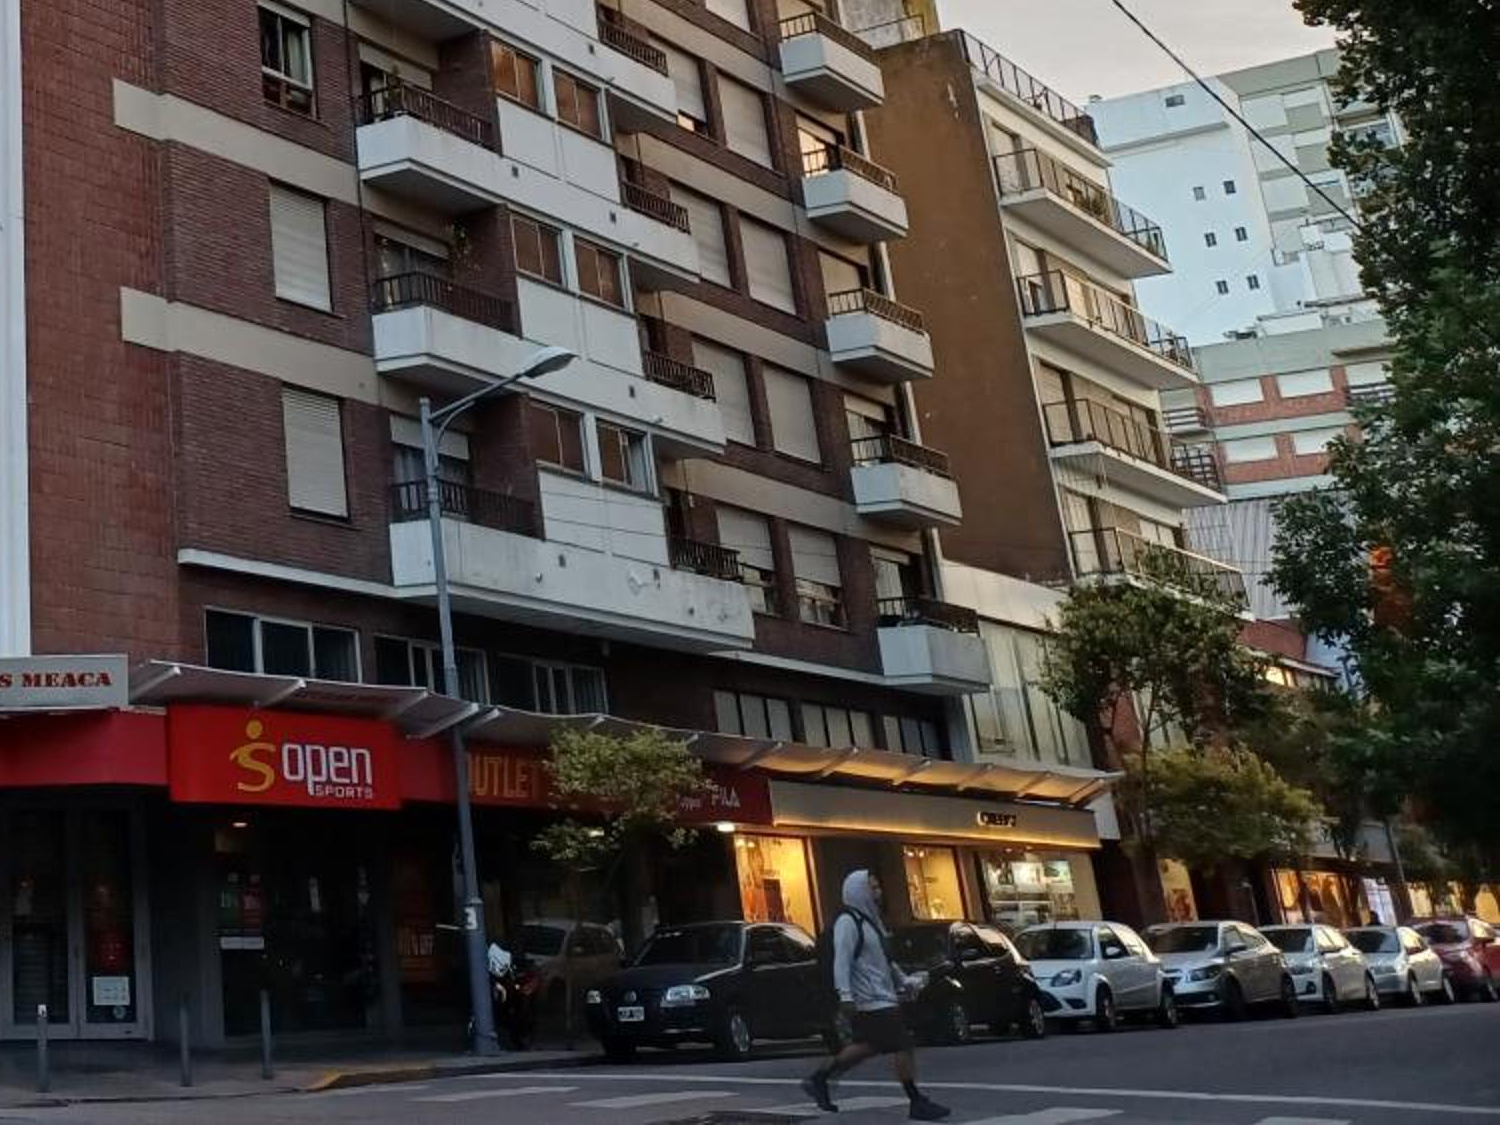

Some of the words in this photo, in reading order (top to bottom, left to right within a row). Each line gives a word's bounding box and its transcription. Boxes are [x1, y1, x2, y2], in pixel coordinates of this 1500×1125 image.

[22, 671, 113, 689] MEACA
[282, 742, 373, 796] open
[315, 784, 374, 800] SPORTS
